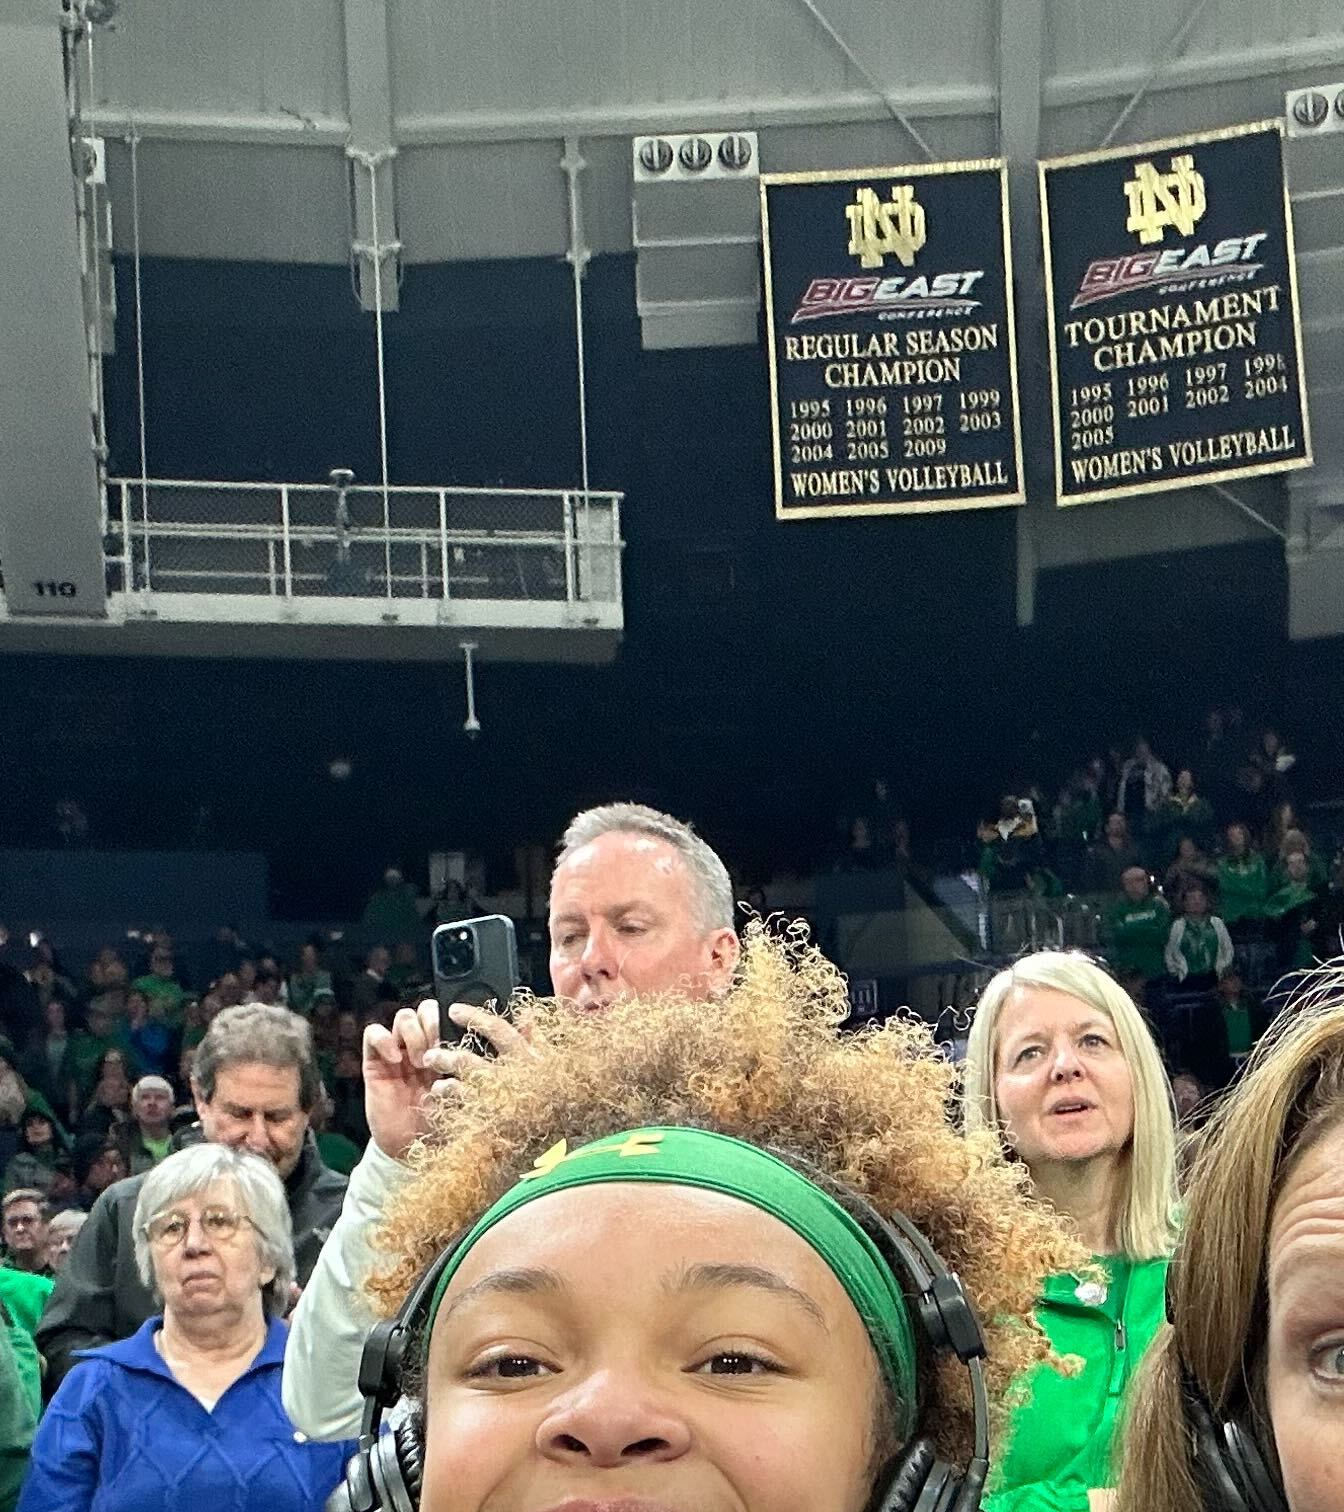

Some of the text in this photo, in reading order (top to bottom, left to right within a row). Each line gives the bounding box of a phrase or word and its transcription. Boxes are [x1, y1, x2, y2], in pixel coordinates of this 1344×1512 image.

[1064, 285, 1282, 348] TOURNAMENT
[785, 324, 997, 360] REGULAR SEASON
[1093, 321, 1257, 372] CHAMPION
[825, 357, 961, 388] CHAMPION
[1071, 382, 1112, 406] 1995
[1127, 373, 1169, 397] 1996
[1185, 363, 1228, 387] 1997
[791, 390, 1001, 419] 1995 1996 1997 1999
[1071, 405, 1114, 429] 2000
[1127, 395, 1169, 418] 2001
[1185, 385, 1229, 409] 2002
[790, 411, 1002, 442] 2000 2001 2002 2003
[791, 438, 946, 464] 2004 2005 2009
[1071, 424, 1296, 484] WOMEN'S VOLLEYBALL
[790, 461, 1008, 498] WOMEN'S VOLLEYBALL
